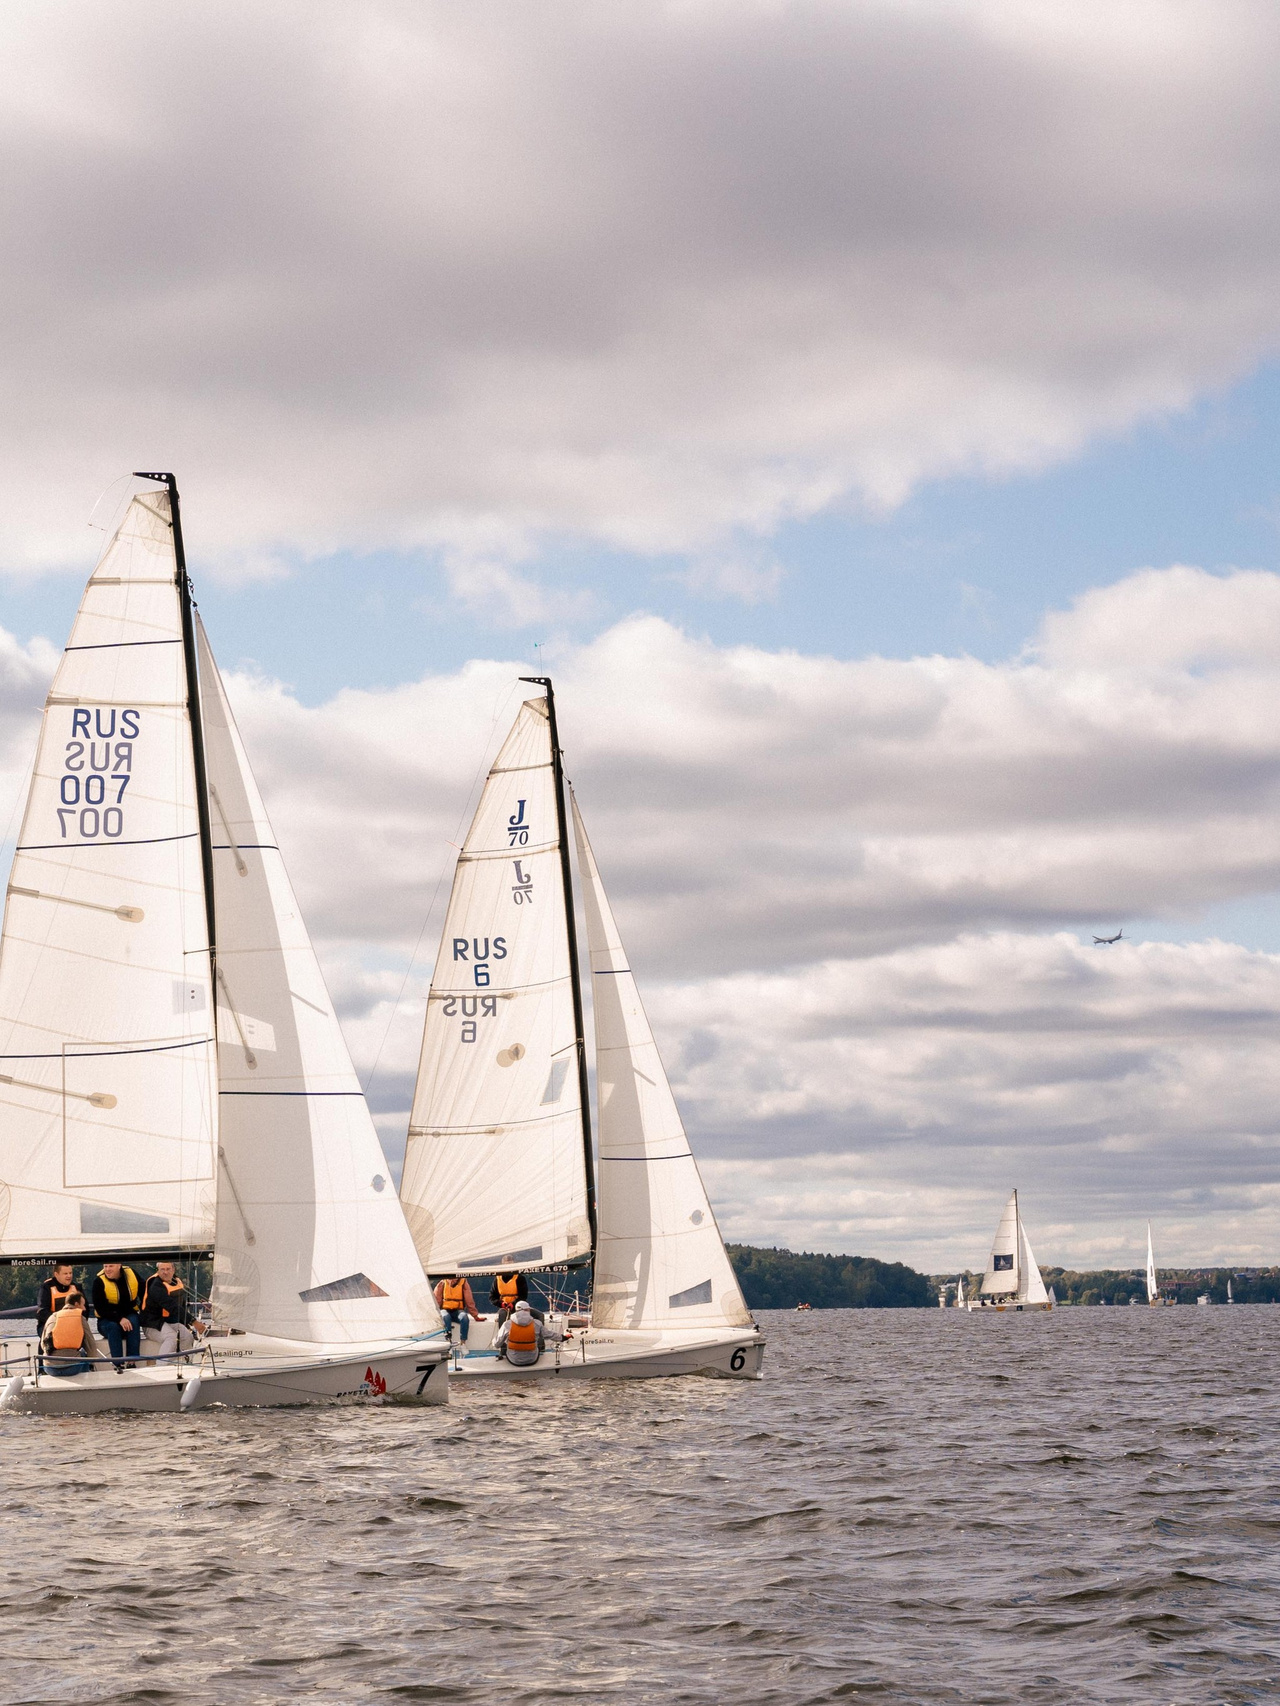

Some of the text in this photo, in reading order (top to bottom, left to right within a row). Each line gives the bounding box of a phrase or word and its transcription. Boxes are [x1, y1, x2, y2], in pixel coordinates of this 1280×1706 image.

[71, 708, 141, 739] RUS
[60, 774, 131, 805] 007
[508, 799, 527, 826] J
[508, 830, 529, 846] 70
[453, 936, 508, 961] RUS
[473, 963, 490, 987] 6
[11, 1258, 57, 1266] MoreSail.ru
[730, 1347, 747, 1371] 6
[415, 1364, 436, 1395] 7
